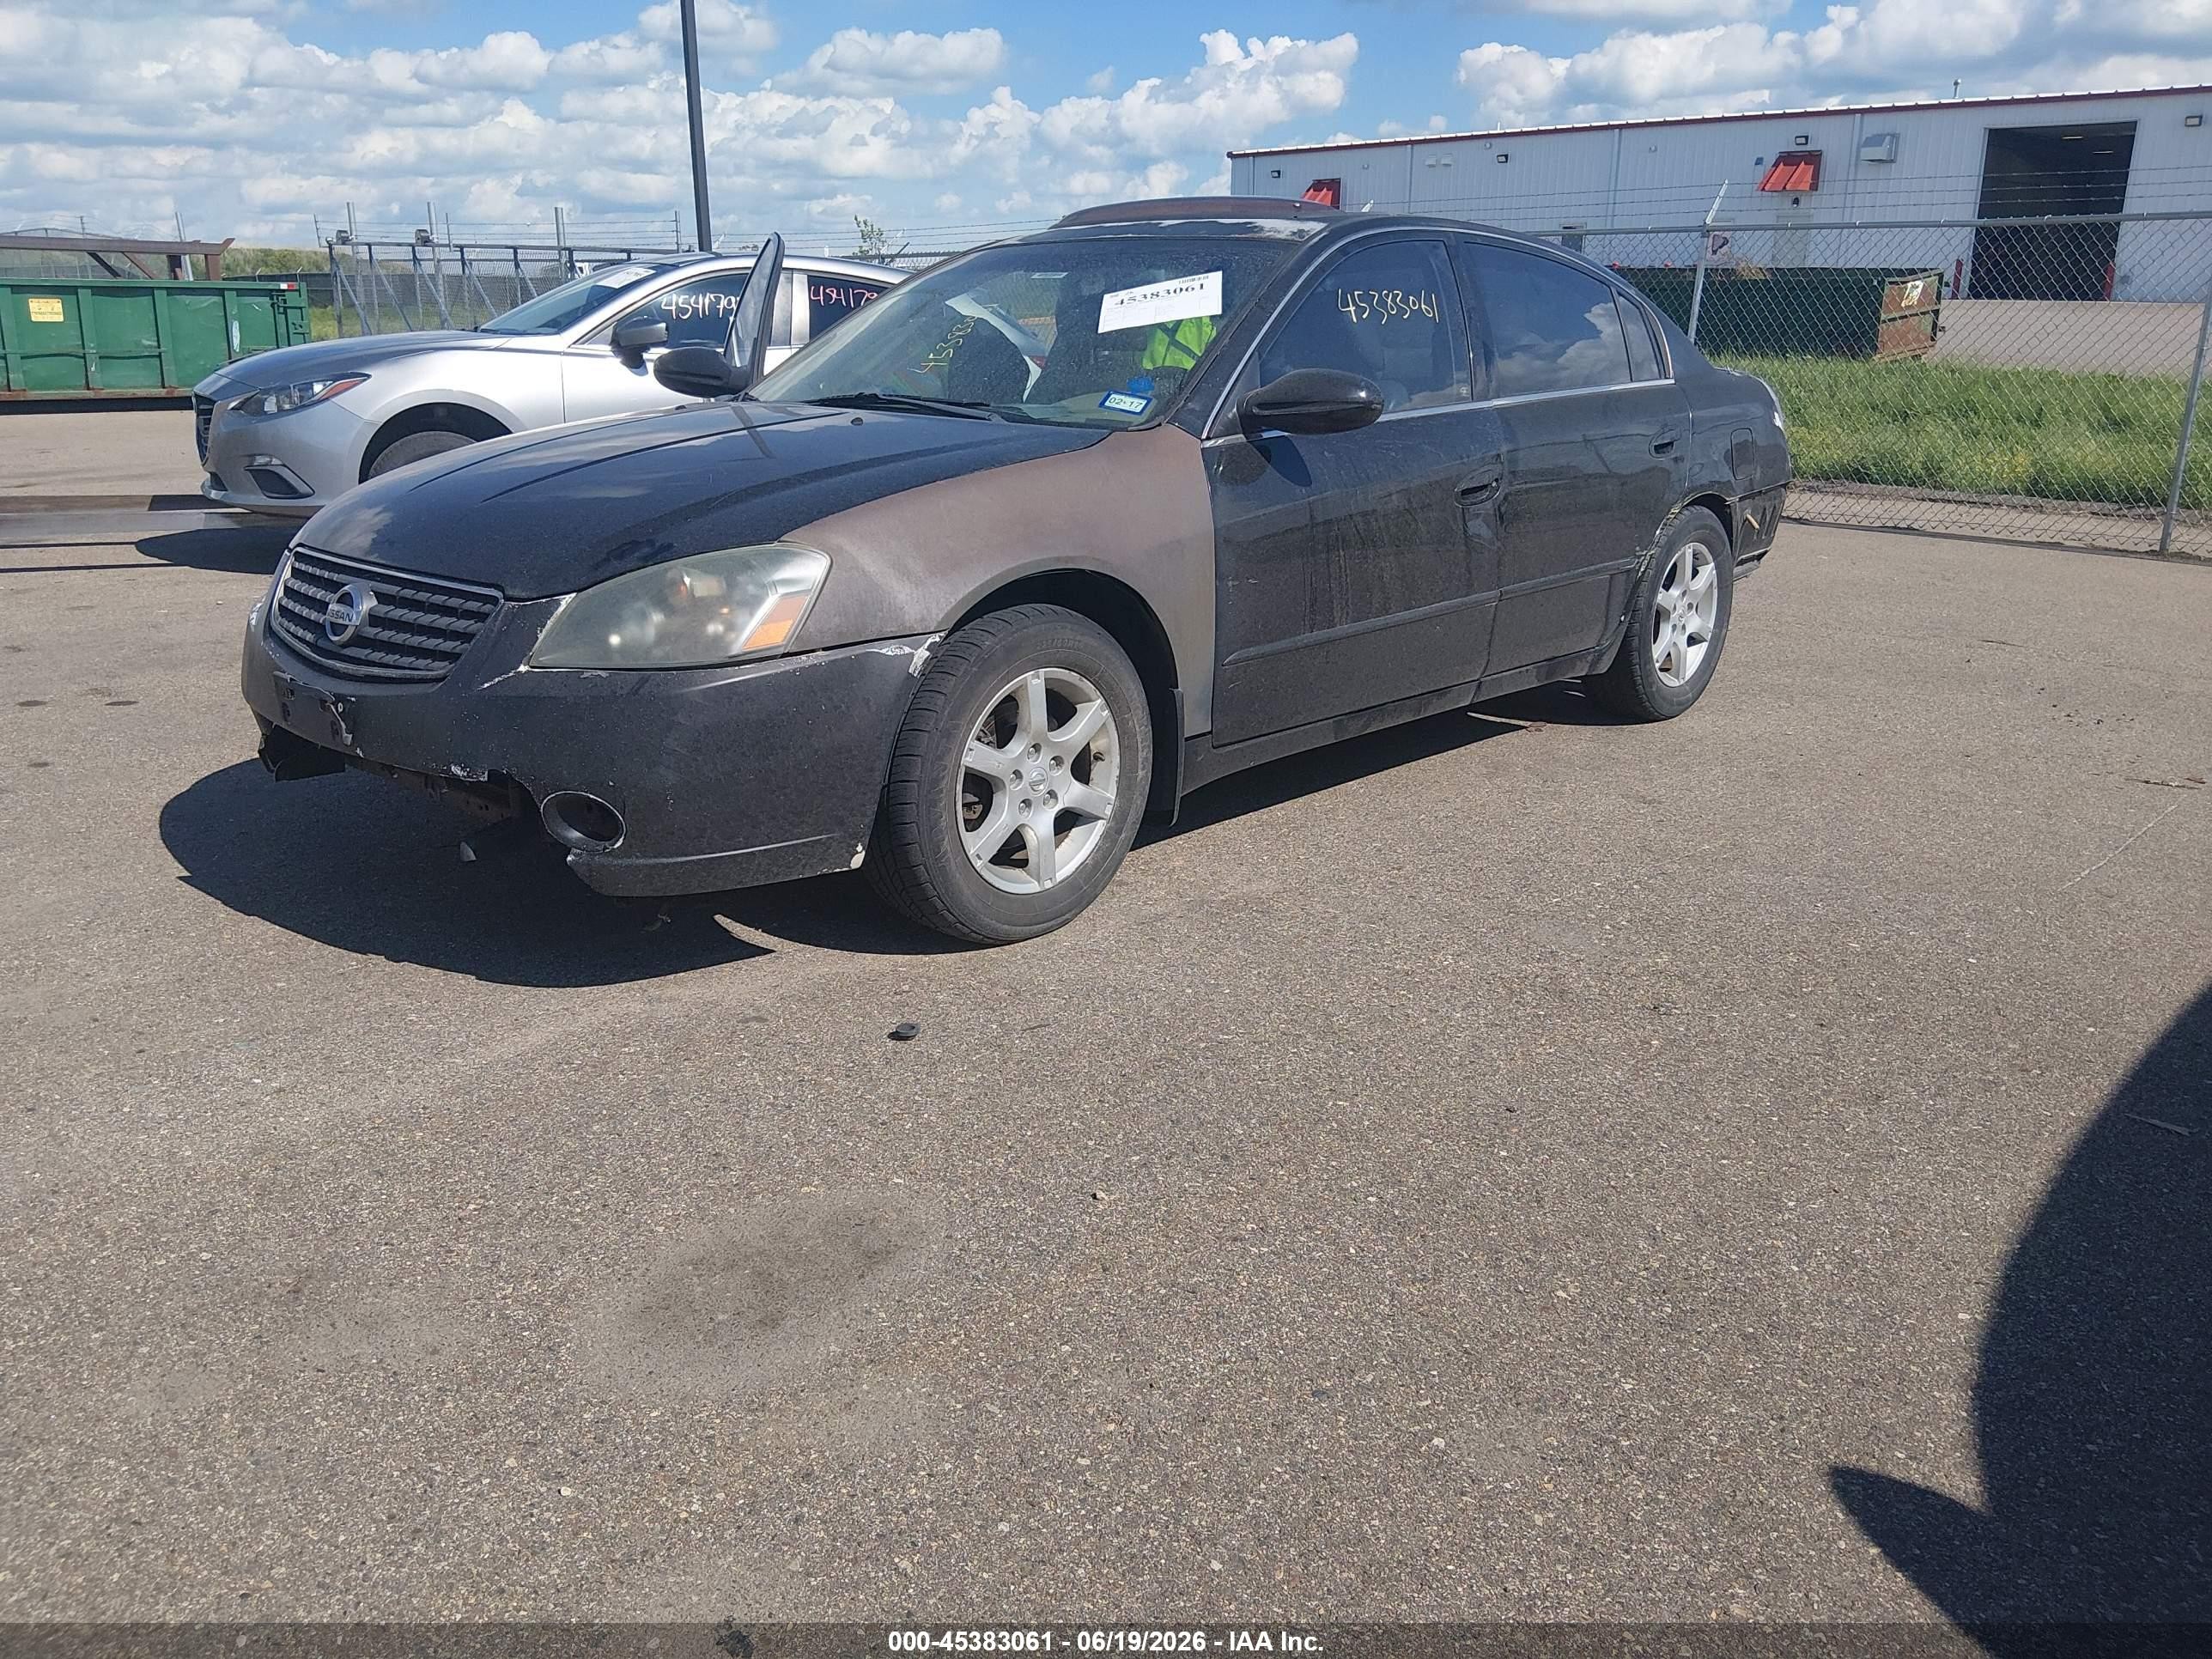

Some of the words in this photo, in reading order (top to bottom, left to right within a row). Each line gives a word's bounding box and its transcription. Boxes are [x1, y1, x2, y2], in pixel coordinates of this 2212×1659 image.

[660, 292, 740, 319] 454179
[1114, 283, 1204, 306] 45383061
[1338, 288, 1439, 325] 45383061
